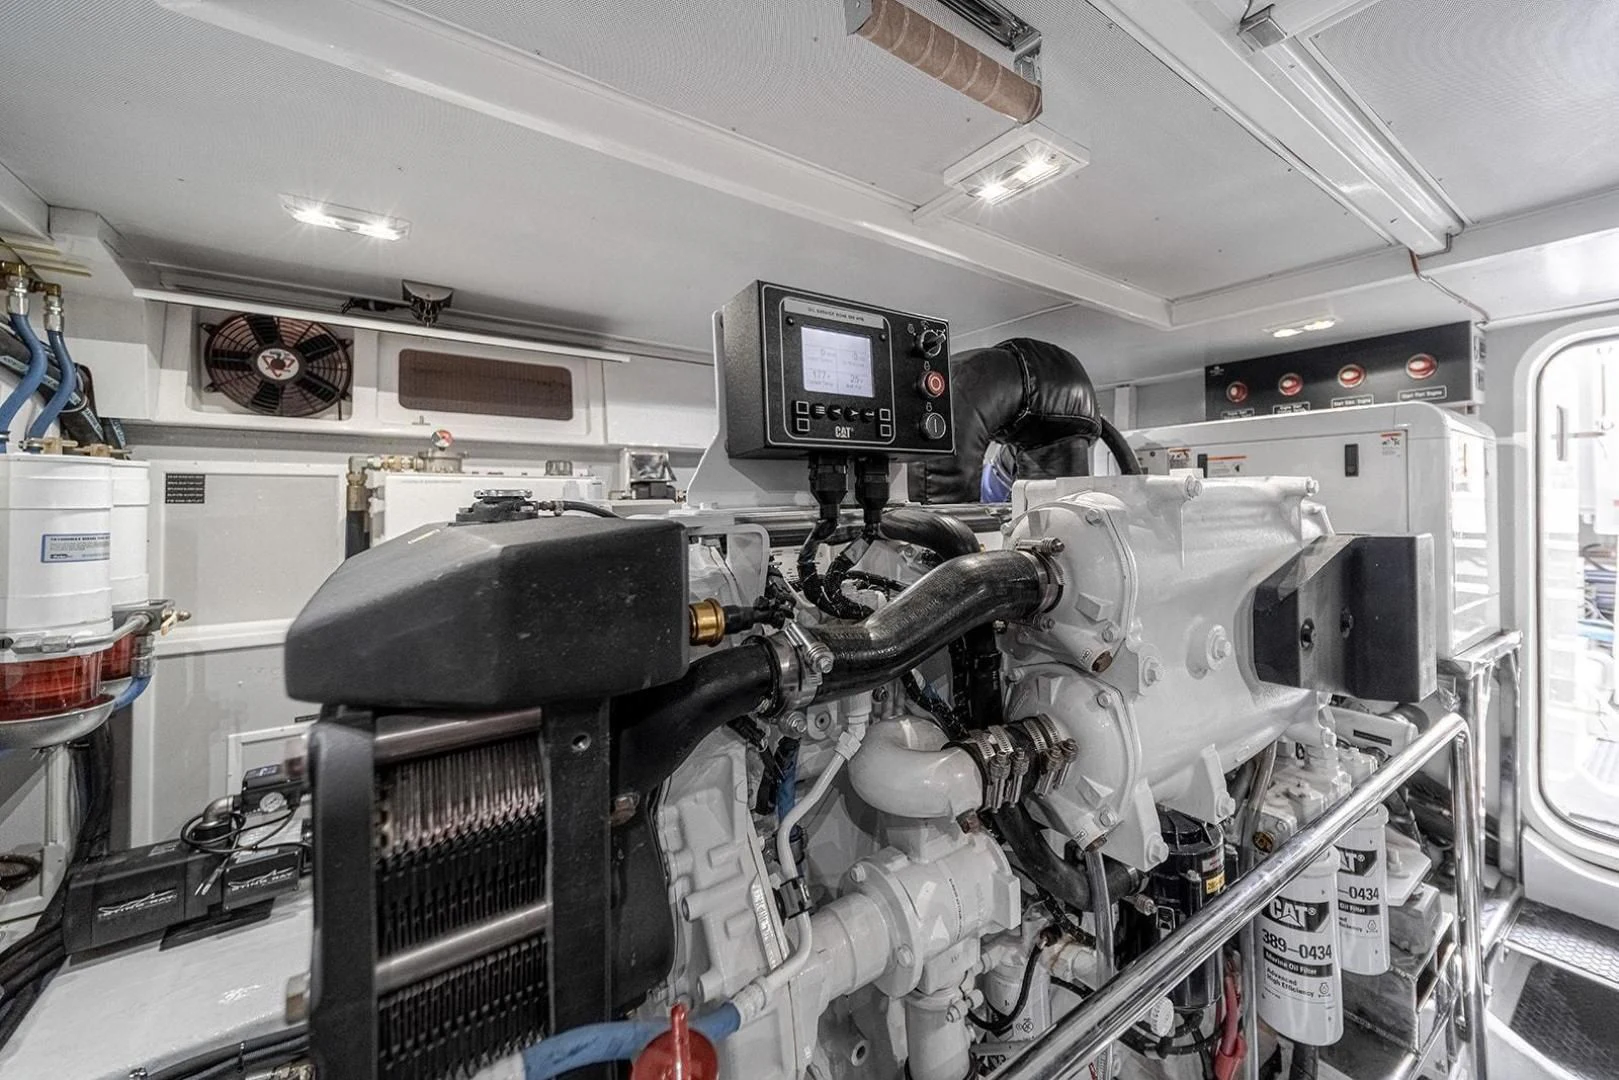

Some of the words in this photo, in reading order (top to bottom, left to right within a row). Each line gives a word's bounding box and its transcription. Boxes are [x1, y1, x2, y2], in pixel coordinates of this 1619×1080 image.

[1266, 967, 1298, 987] Advanced
[1288, 962, 1299, 972] Oil
[1299, 966, 1317, 976] Filter
[1281, 982, 1315, 998] Efficiency
